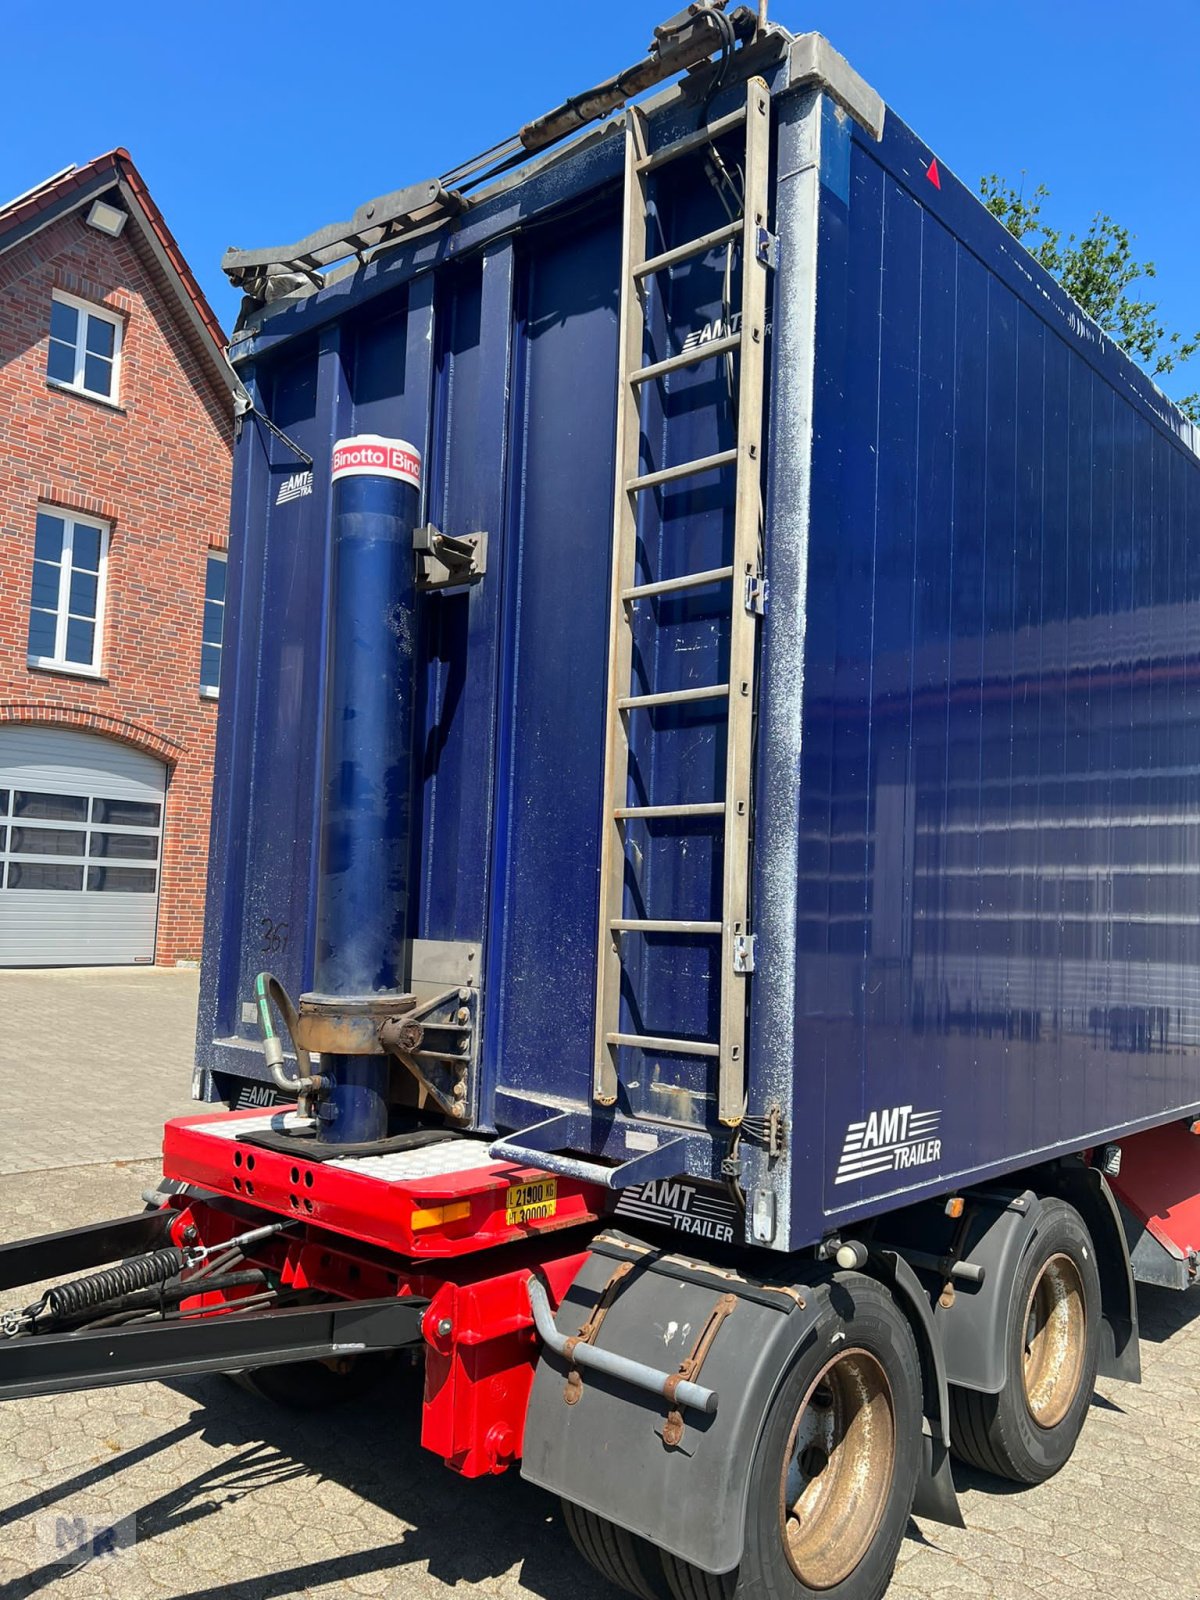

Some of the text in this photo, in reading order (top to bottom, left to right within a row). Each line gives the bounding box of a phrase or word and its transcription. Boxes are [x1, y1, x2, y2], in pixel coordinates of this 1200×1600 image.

[333, 448, 385, 469] Binotto
[288, 470, 310, 491] AMT
[248, 1085, 278, 1108] AMT
[862, 1104, 913, 1149] AMT
[893, 1139, 942, 1171] TRAILER
[516, 1184, 543, 1206] 21900
[640, 1179, 697, 1212] AMT
[673, 1213, 734, 1244] TRAILER
